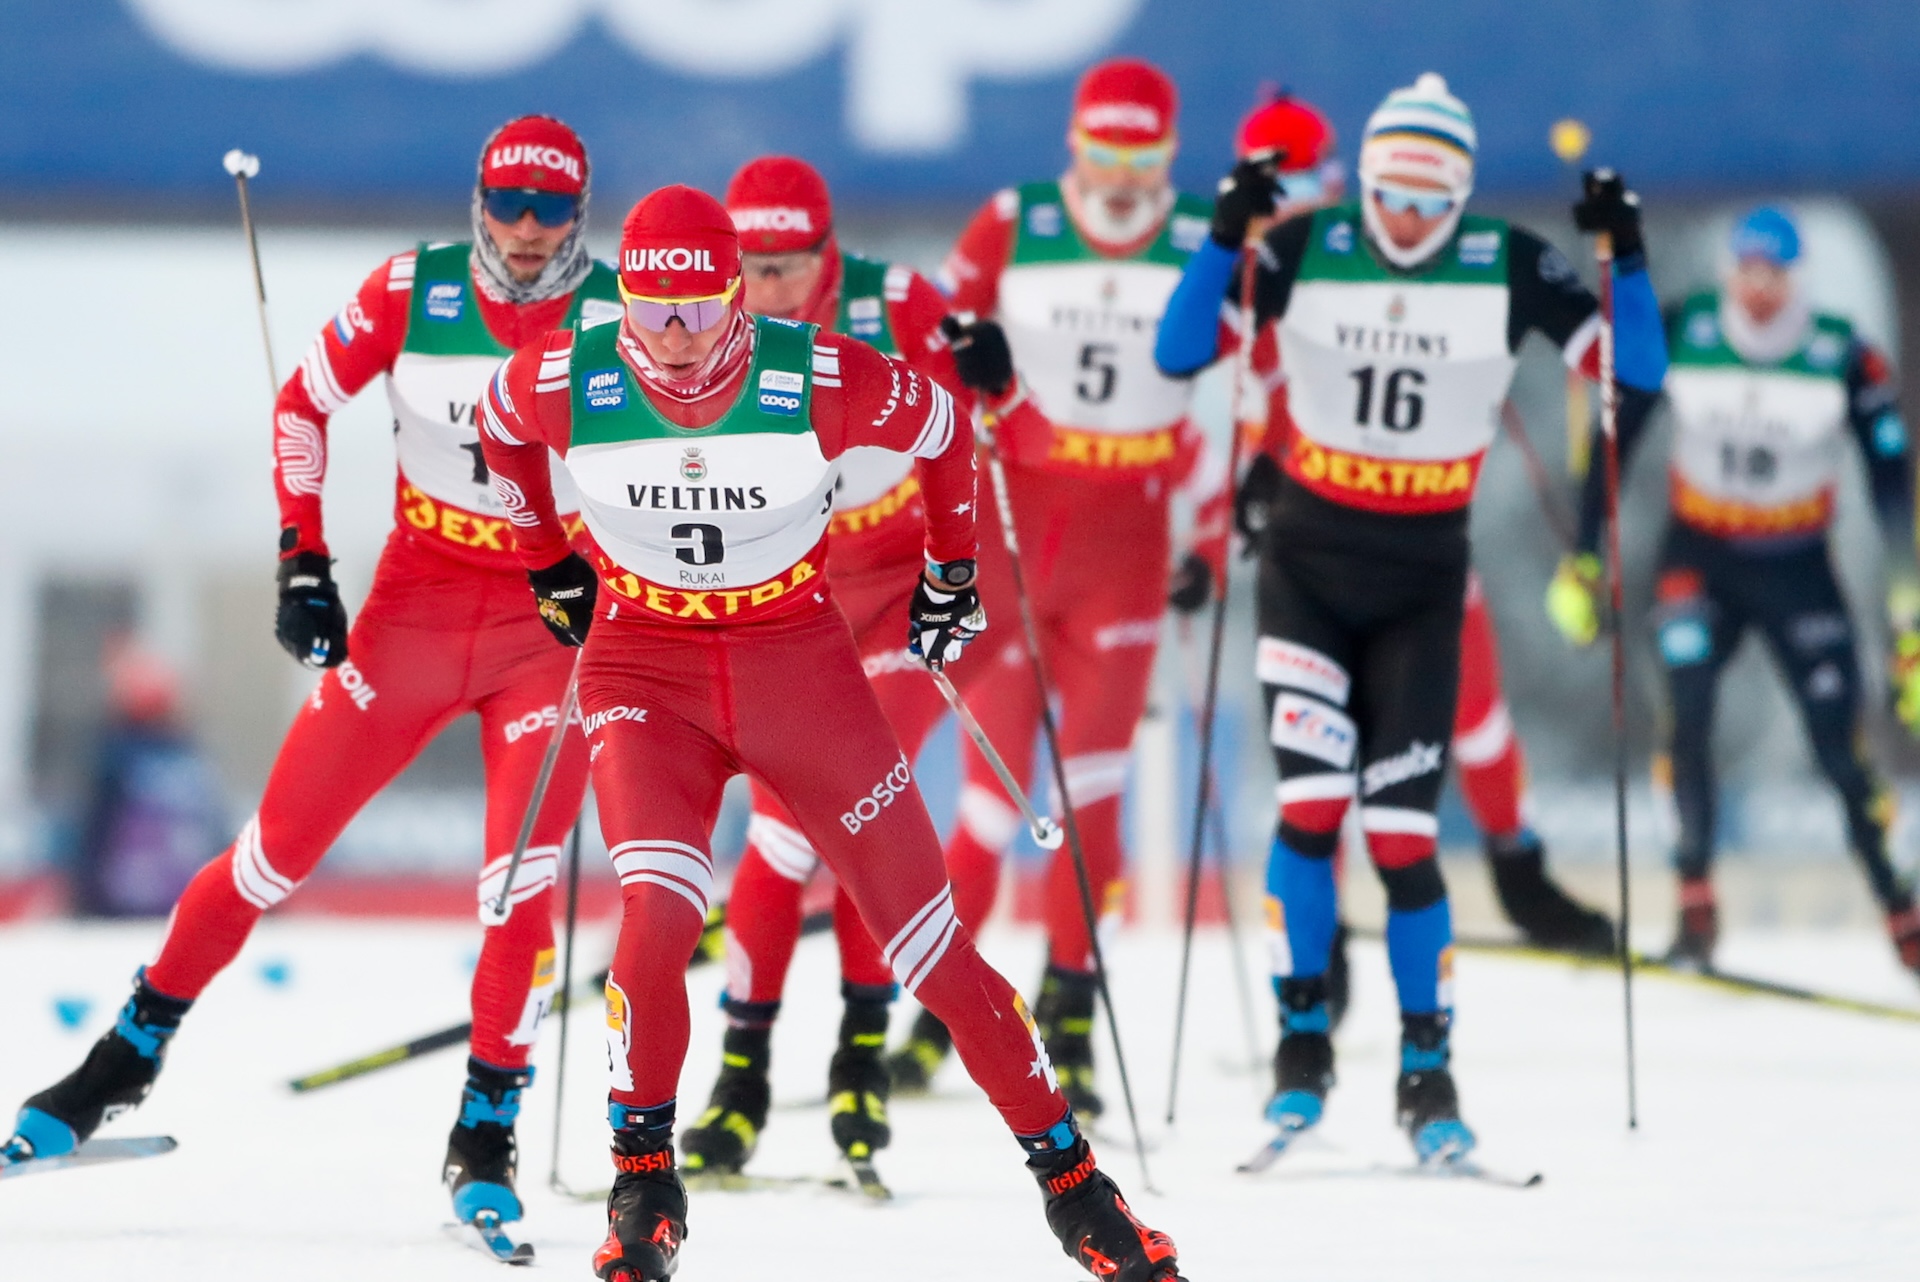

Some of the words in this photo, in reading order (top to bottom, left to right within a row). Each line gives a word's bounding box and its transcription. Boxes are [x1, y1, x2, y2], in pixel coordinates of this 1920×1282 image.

[491, 145, 580, 181] LUKOIL
[625, 248, 715, 272] LUKOIL
[1077, 343, 1116, 404] 5
[590, 395, 621, 407] coop
[760, 394, 800, 411] coop
[1349, 365, 1428, 433] 16
[627, 484, 767, 511] VELTINS
[671, 523, 725, 566] 3
